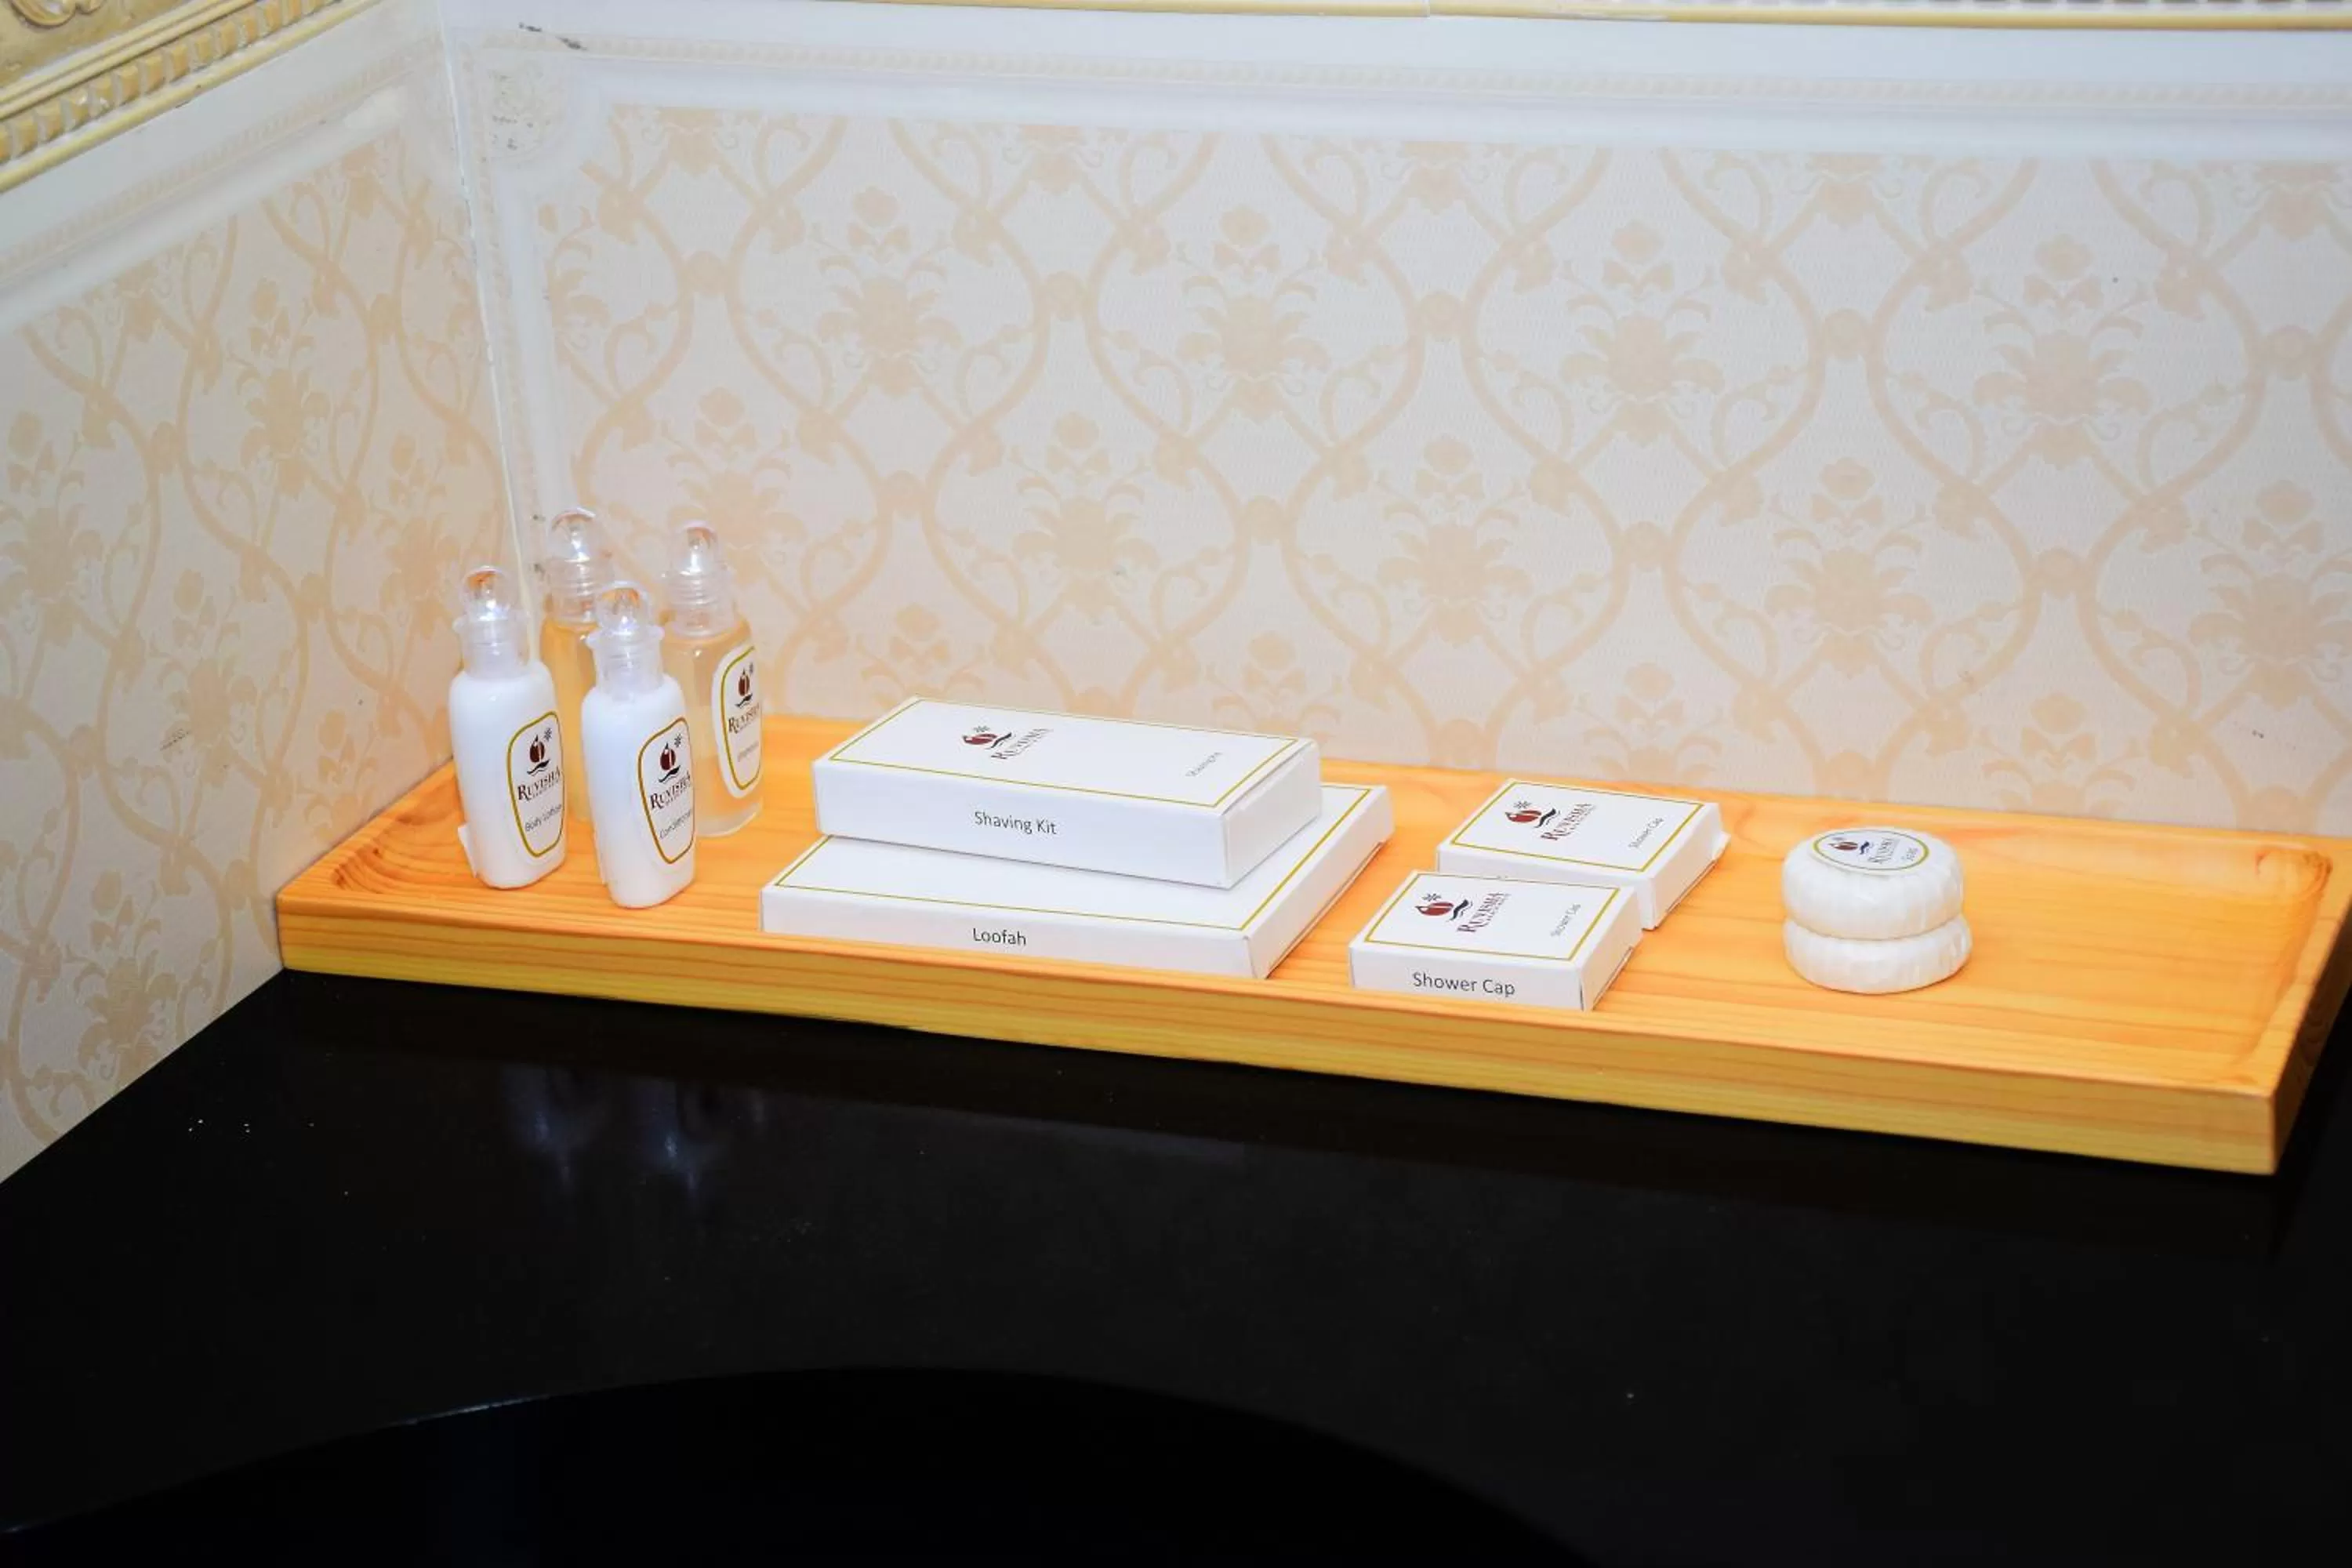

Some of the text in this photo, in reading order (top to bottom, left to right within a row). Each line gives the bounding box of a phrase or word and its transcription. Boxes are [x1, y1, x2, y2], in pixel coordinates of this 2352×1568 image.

[975, 811, 1057, 835] Shaving Kit
[973, 927, 1026, 946] Loofah
[1413, 971, 1515, 997] Shower Cap
